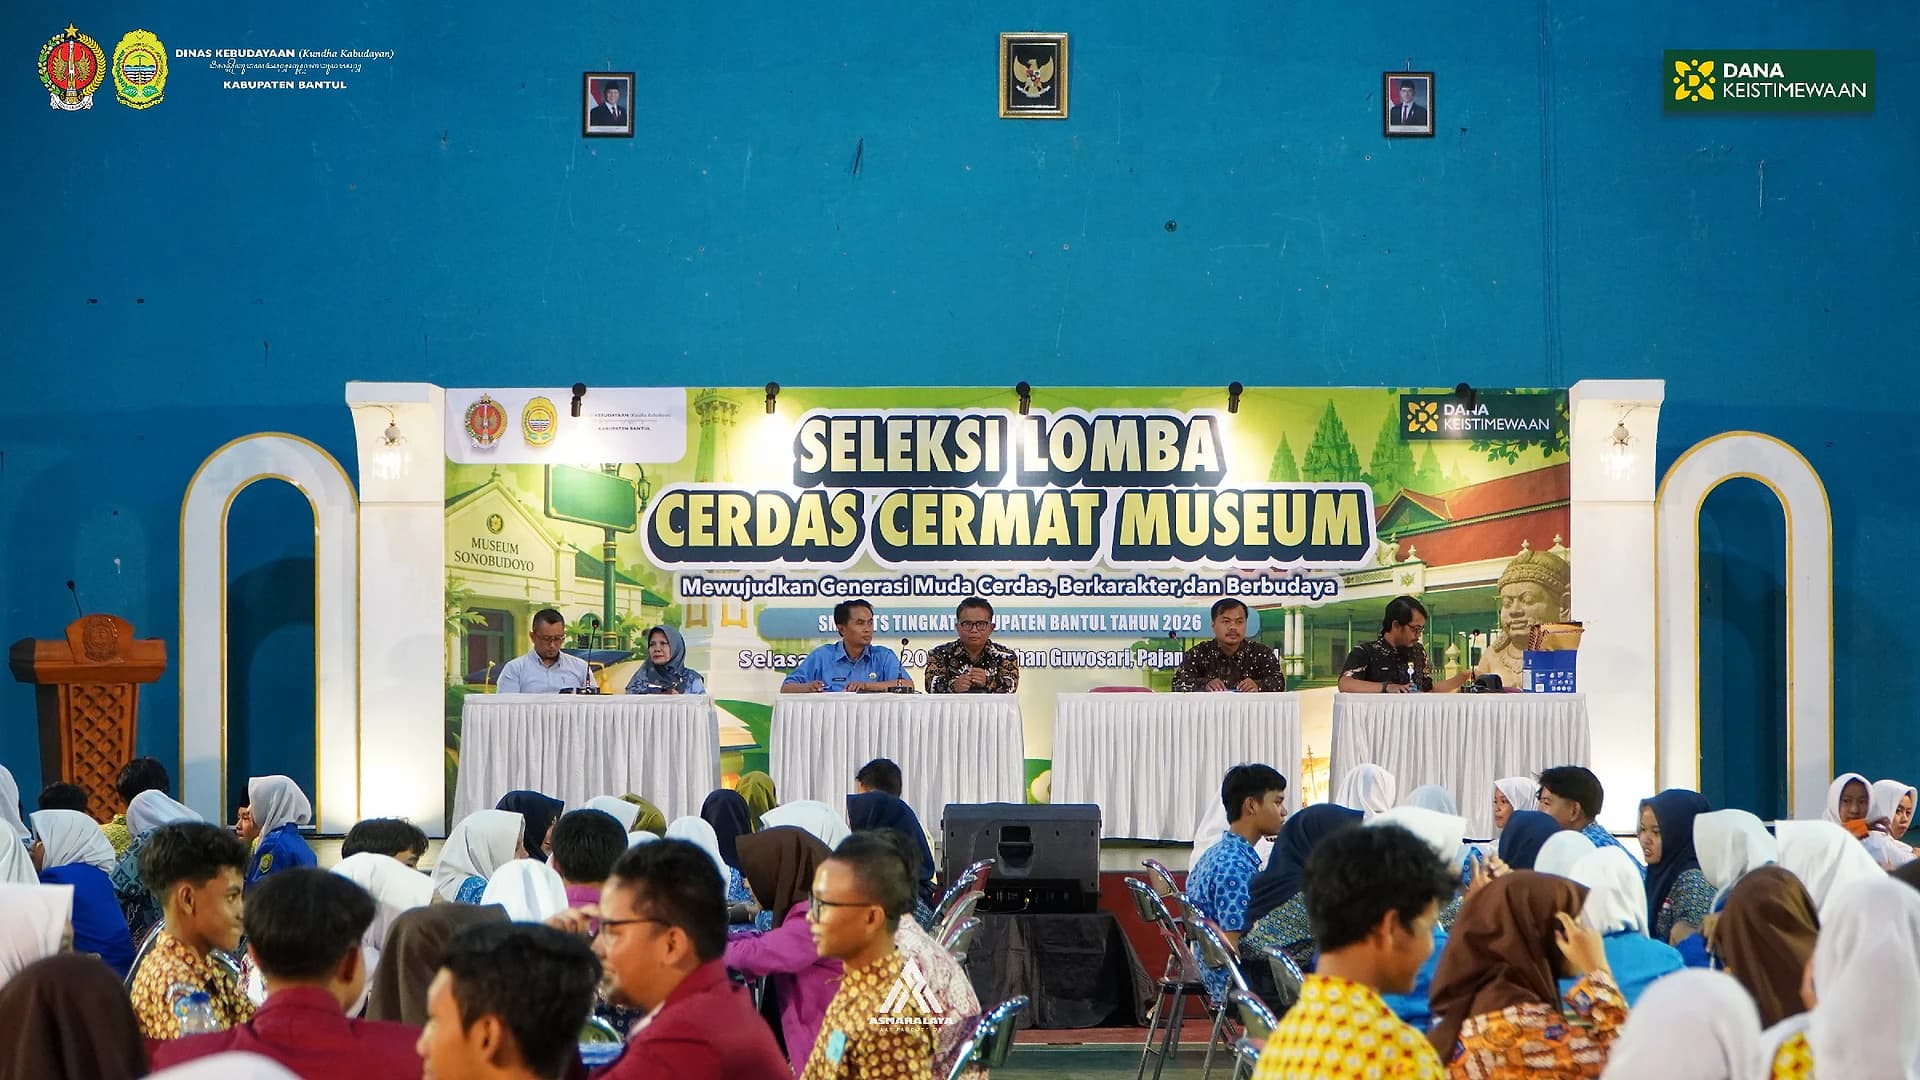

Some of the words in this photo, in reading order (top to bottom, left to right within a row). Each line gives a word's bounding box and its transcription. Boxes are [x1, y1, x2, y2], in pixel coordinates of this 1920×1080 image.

[1443, 418, 1550, 431] KEISTIMEWAAN
[798, 418, 1002, 474] SELEKSI
[1022, 418, 1219, 474] LOMBA
[654, 492, 860, 548] CERDAS
[878, 492, 1100, 548] CERMAT
[1118, 492, 1364, 548] MUSEUM
[471, 537, 519, 555] MUSEUM
[454, 551, 534, 572] SONOBUDOYO
[682, 577, 814, 598] Mewujudkan
[819, 577, 909, 596] Generasi
[915, 577, 973, 595] Muda
[977, 577, 1054, 598] Cerdas,
[1227, 577, 1336, 599] Berbudaya
[892, 614, 956, 632] TINGKAT
[1050, 614, 1106, 632] BANTUL
[1111, 614, 1159, 632] TAHUN
[1163, 614, 1202, 632] 2026
[1050, 649, 1135, 668] Guwosari,
